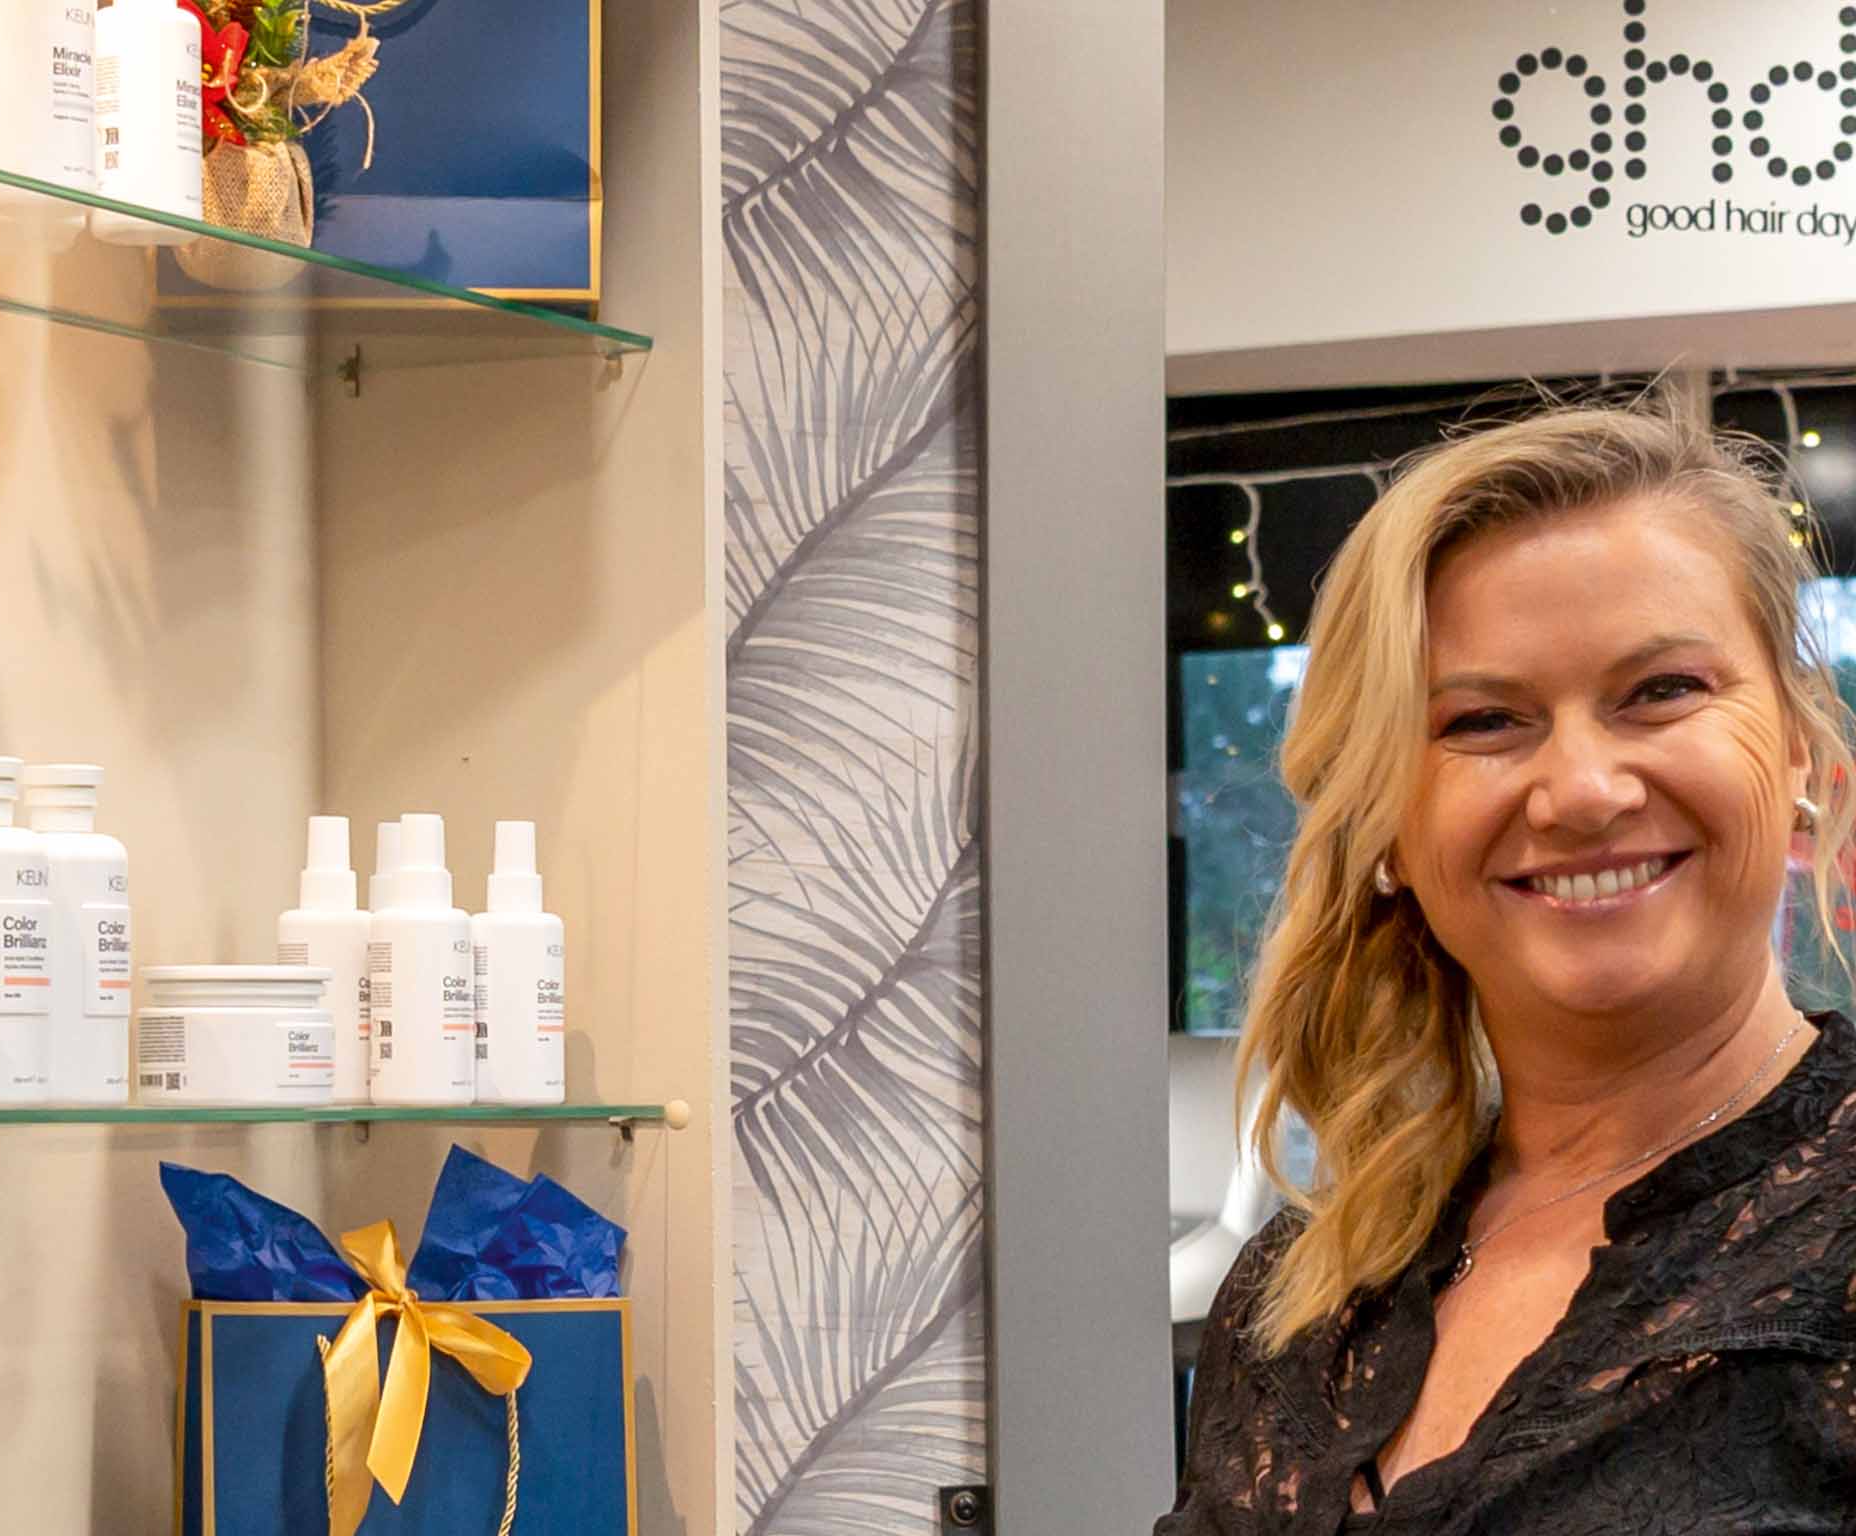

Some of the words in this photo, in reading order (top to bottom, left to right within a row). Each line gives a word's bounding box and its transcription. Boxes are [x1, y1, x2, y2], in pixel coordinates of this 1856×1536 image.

[65, 7, 95, 26] KEUN
[1626, 200, 1715, 238] good
[1726, 202, 1790, 234] hair
[3, 916, 37, 932] Color
